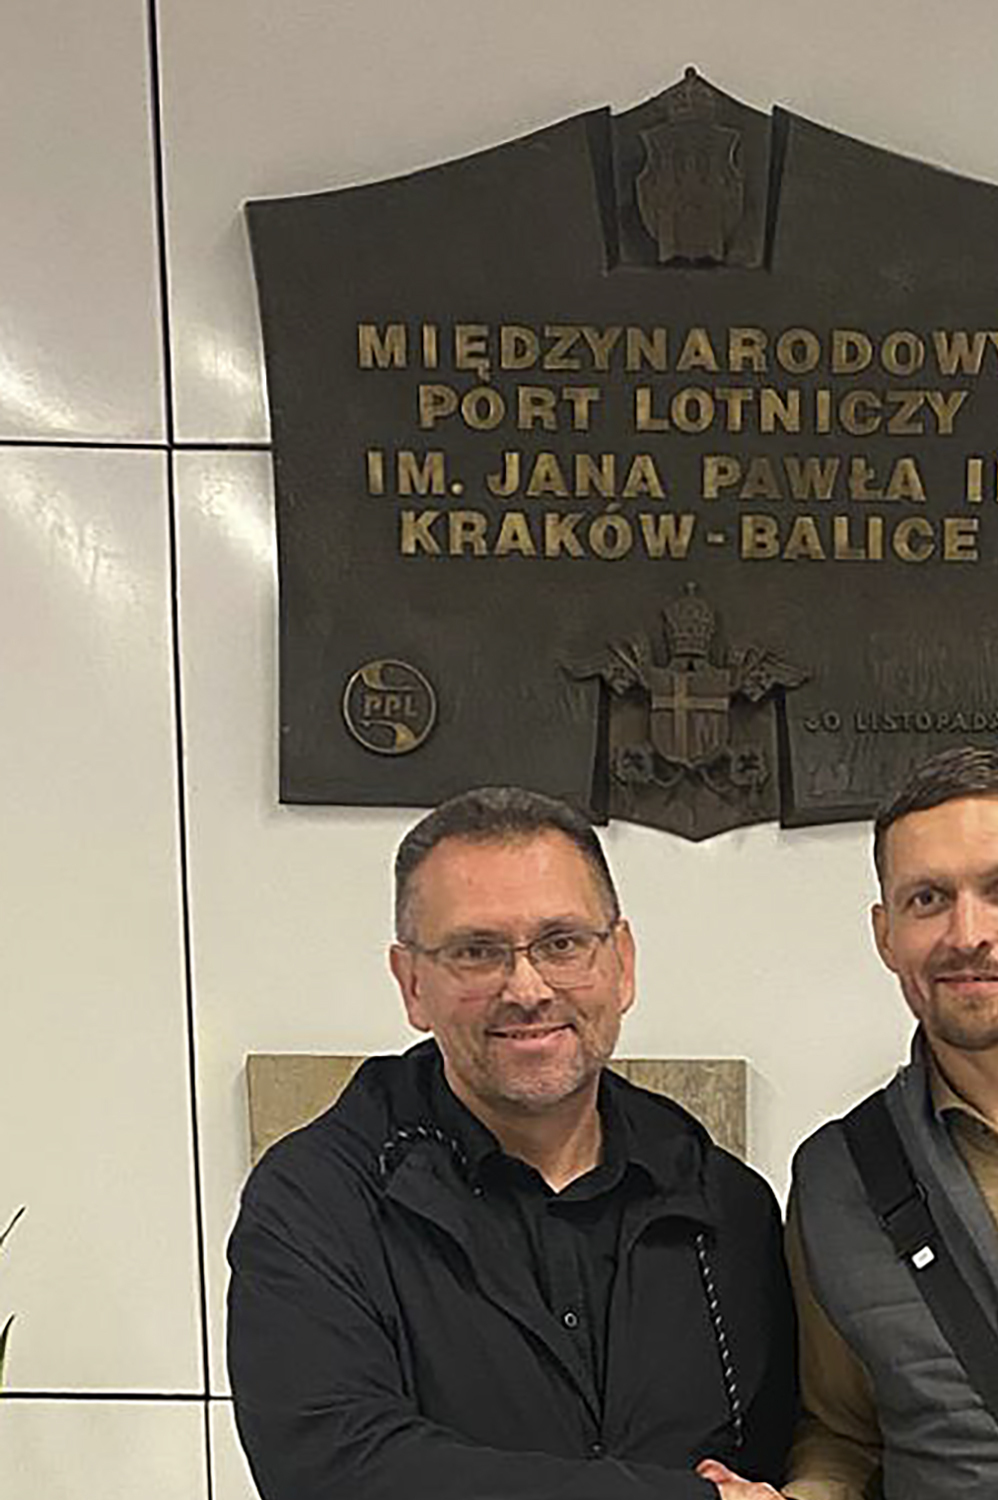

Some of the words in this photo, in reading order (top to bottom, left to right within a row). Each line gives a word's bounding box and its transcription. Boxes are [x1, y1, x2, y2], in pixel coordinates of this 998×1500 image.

[418, 384, 599, 430] PORT
[635, 386, 969, 435] LOTNICZY
[367, 450, 463, 496] IM.
[487, 452, 665, 498] JANA
[702, 455, 926, 500] PAWŁA
[363, 694, 418, 717] PPL
